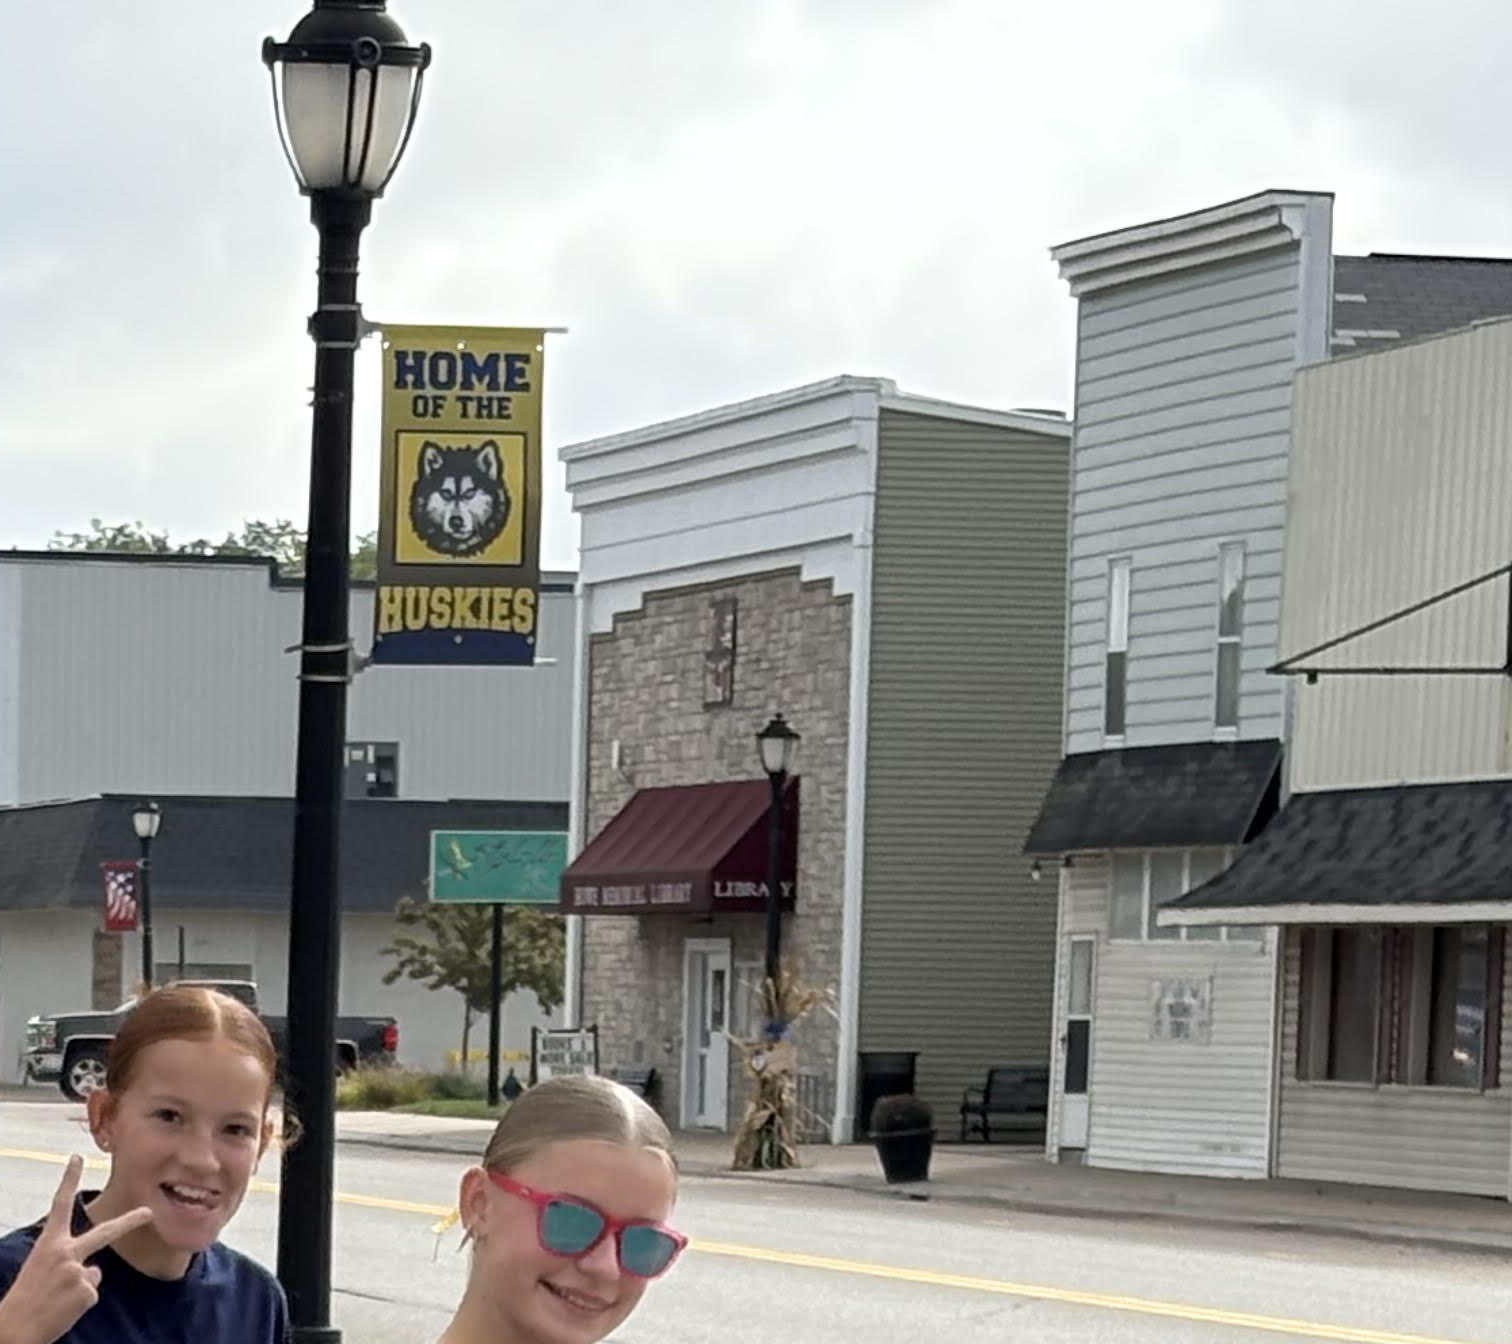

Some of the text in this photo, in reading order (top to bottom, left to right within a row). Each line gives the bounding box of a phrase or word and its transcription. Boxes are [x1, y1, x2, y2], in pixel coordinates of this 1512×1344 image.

[394, 350, 530, 392] HOME
[412, 394, 512, 420] OF THE
[378, 586, 535, 633] HUSKIES
[714, 880, 794, 898] LIBRAY
